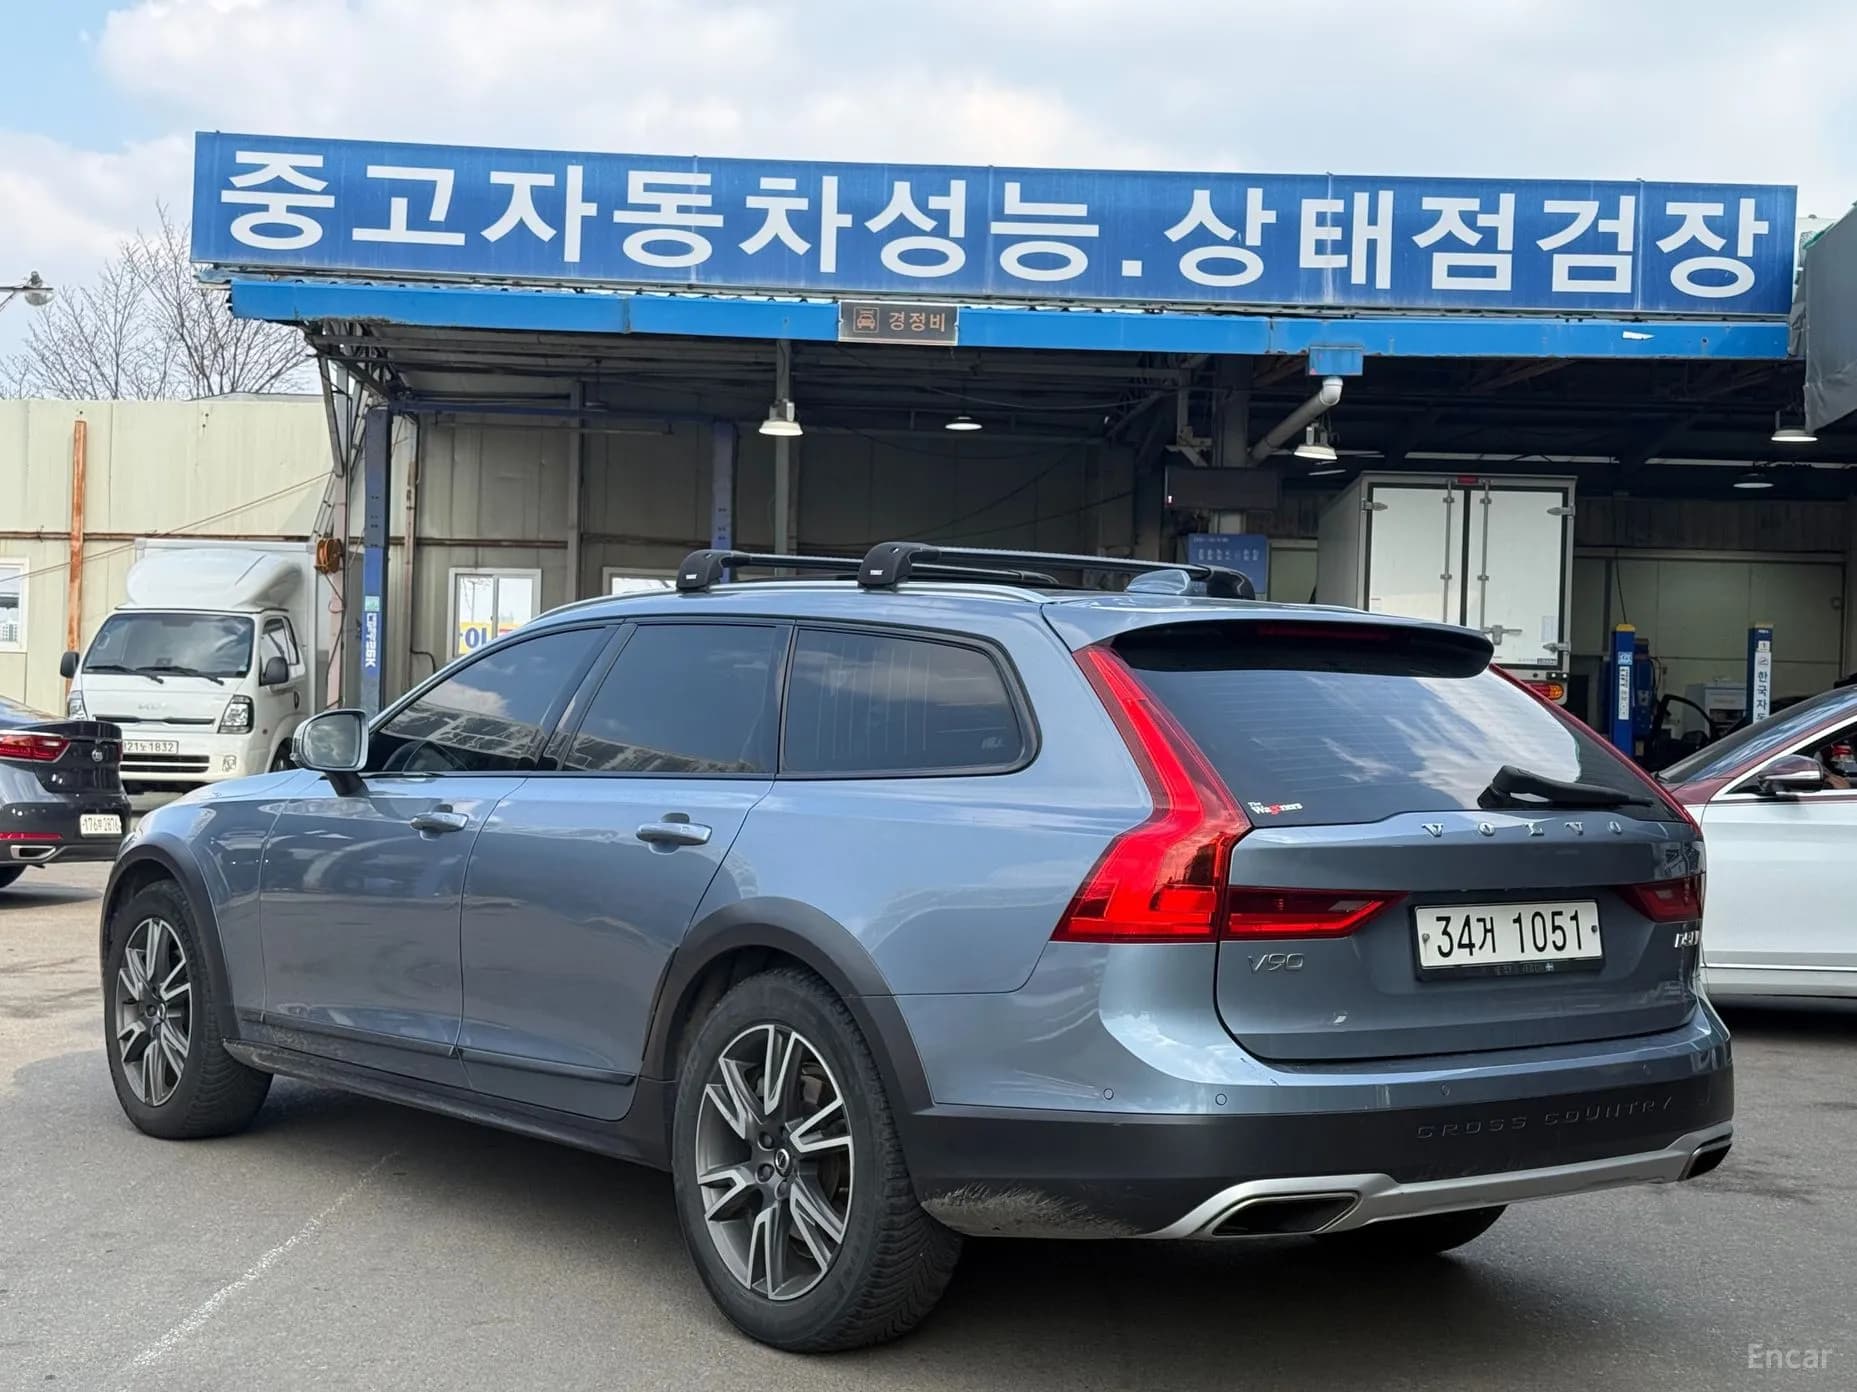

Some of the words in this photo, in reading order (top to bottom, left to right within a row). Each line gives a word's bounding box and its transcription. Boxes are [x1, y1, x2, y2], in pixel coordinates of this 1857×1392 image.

[888, 311, 945, 333] 경정비
[1421, 821, 1623, 837] VOLVO
[1512, 909, 1583, 954] 1051
[1248, 953, 1304, 972] V90
[1416, 1116, 1528, 1139] CROSS
[1544, 1096, 1672, 1126] COUNTRY
